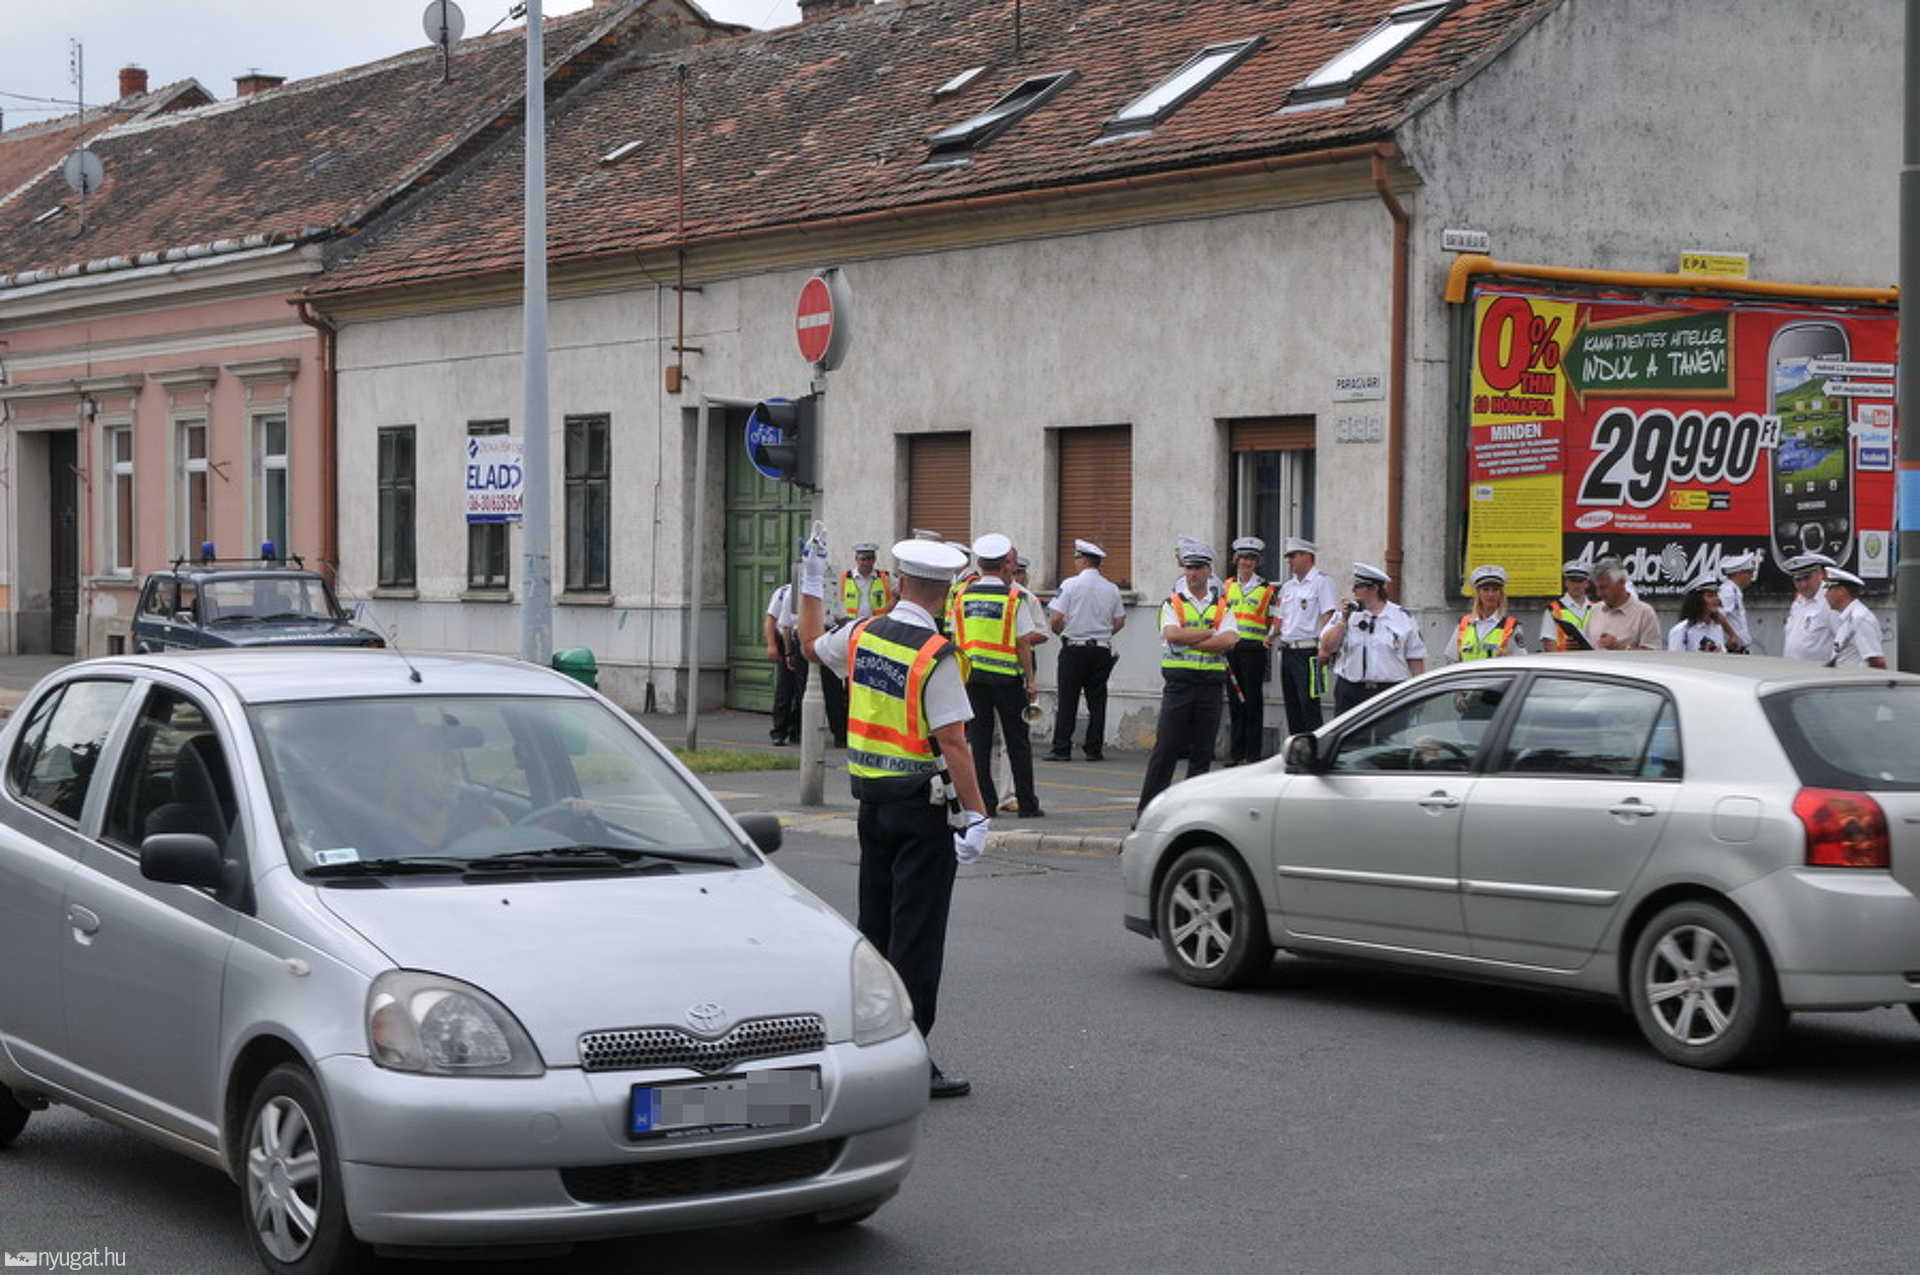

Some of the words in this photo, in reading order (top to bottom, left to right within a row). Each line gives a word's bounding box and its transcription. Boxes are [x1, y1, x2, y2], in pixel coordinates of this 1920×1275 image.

[1478, 296, 1562, 392] 0%
[1646, 353, 1659, 378] A
[1520, 371, 1556, 395] THM
[1491, 423, 1542, 441] MINDEN
[1760, 420, 1778, 443] Ft
